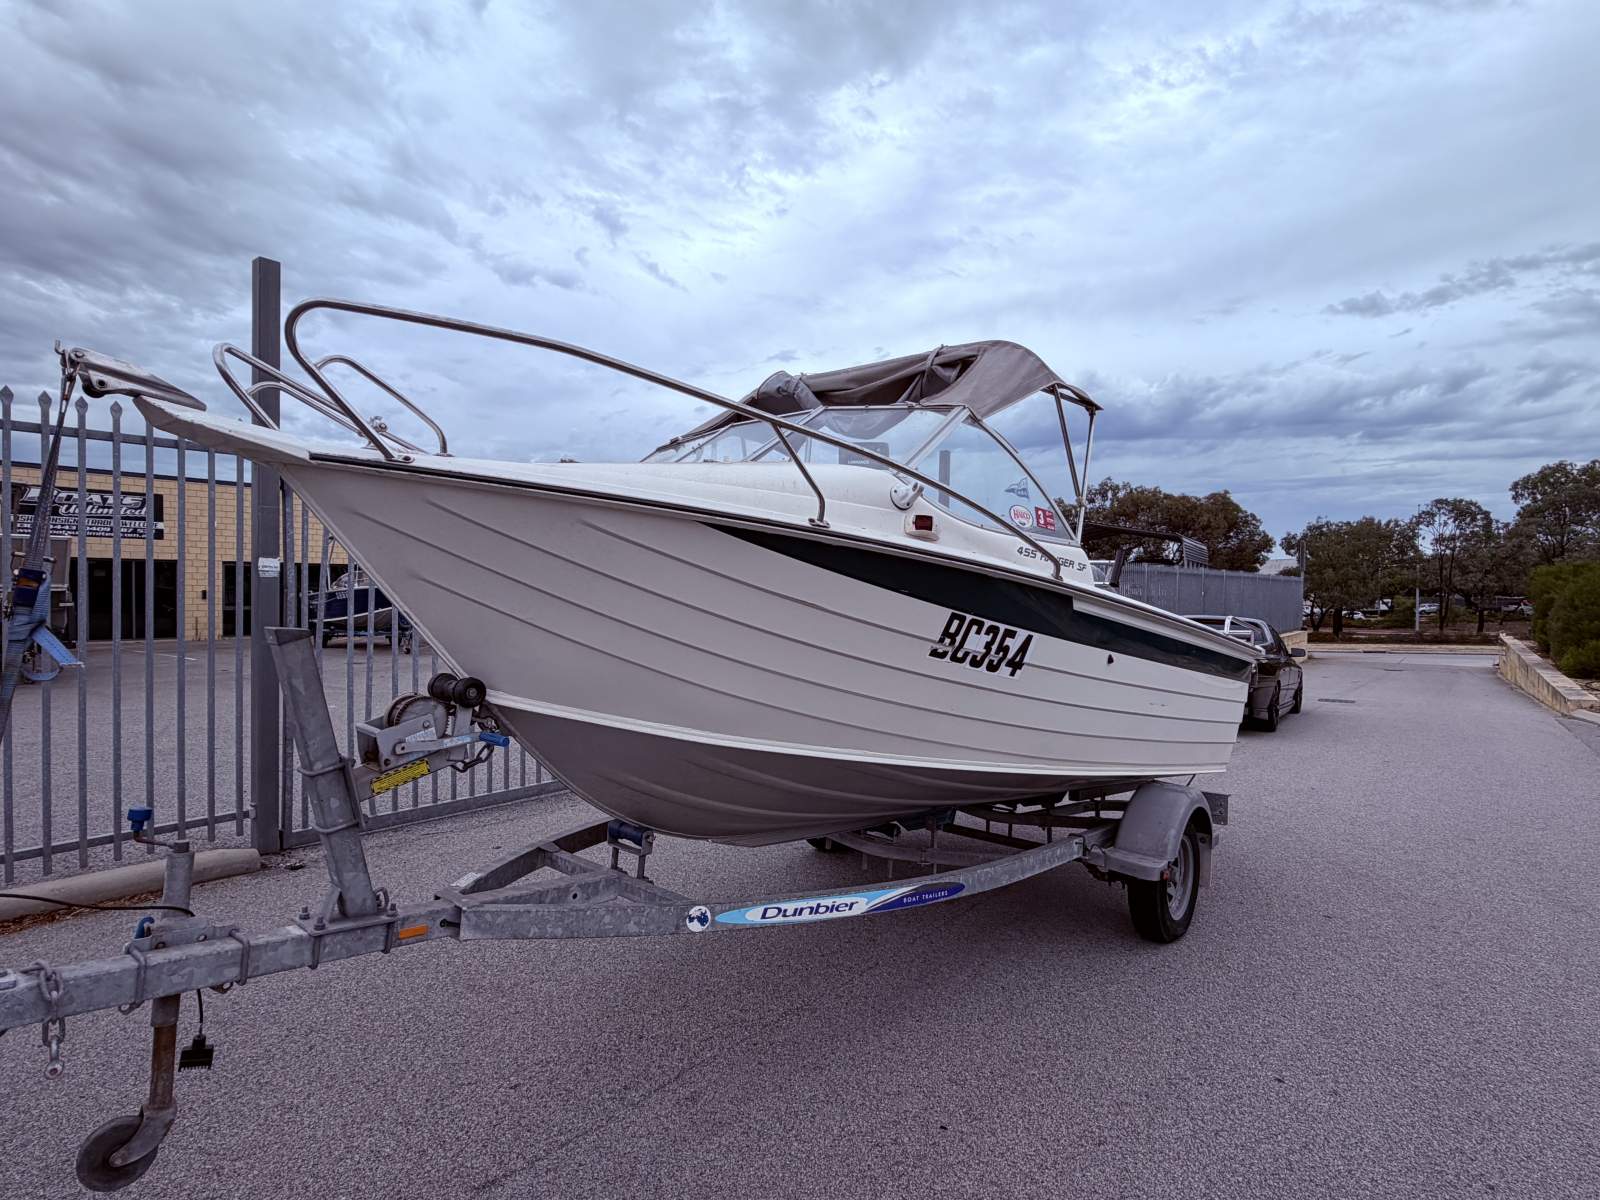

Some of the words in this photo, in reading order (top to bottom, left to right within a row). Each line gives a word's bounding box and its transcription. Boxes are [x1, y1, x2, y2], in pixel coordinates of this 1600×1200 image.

[1016, 546, 1038, 559] 455
[928, 611, 1034, 677] BC354
[903, 895, 920, 904] BOAT
[922, 890, 948, 900] TRAILERS
[760, 901, 860, 920] Dunbier
